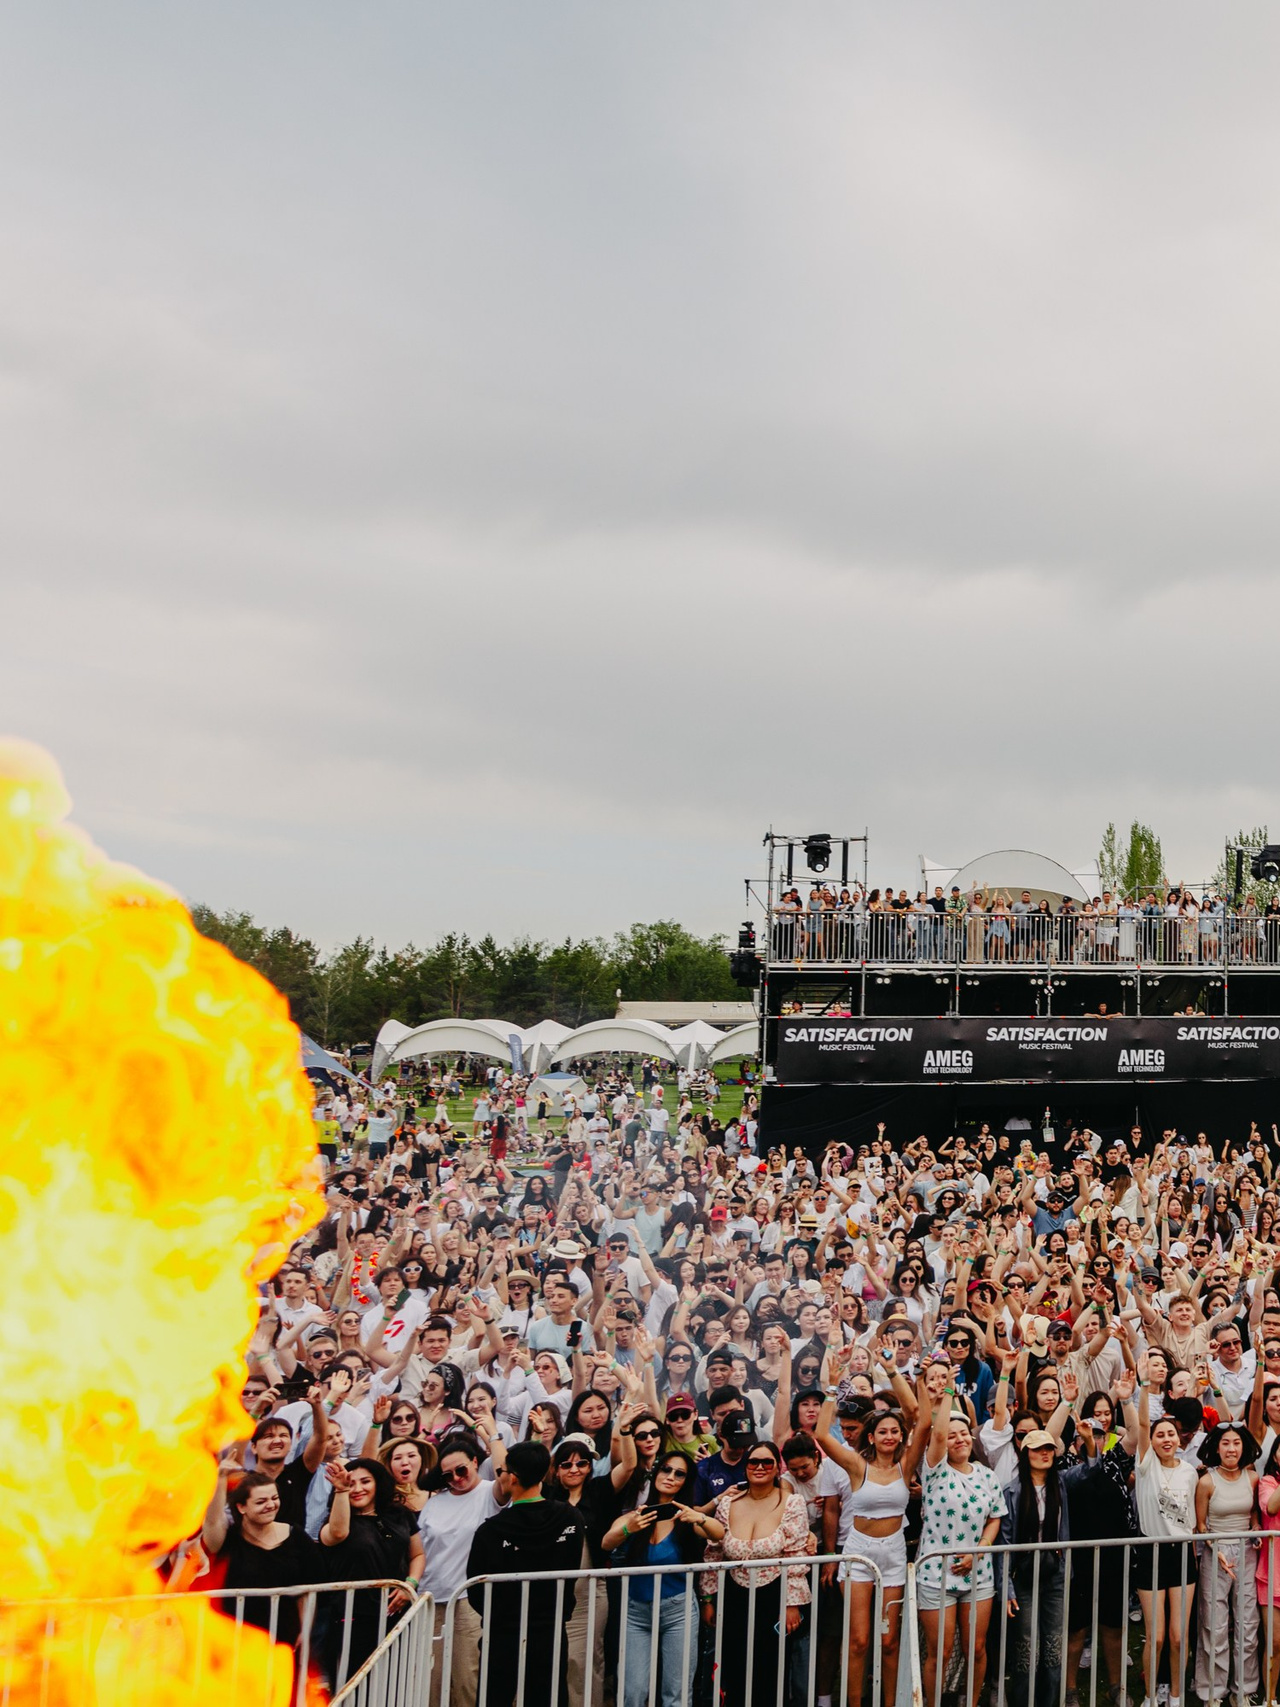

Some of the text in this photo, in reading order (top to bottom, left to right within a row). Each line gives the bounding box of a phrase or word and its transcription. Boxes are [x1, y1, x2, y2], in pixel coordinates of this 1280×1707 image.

[784, 1028, 913, 1042] SATISFACTION
[986, 1027, 1108, 1042] SATISFACTION
[923, 1050, 974, 1067] AMEG
[1118, 1049, 1165, 1066] AMEG
